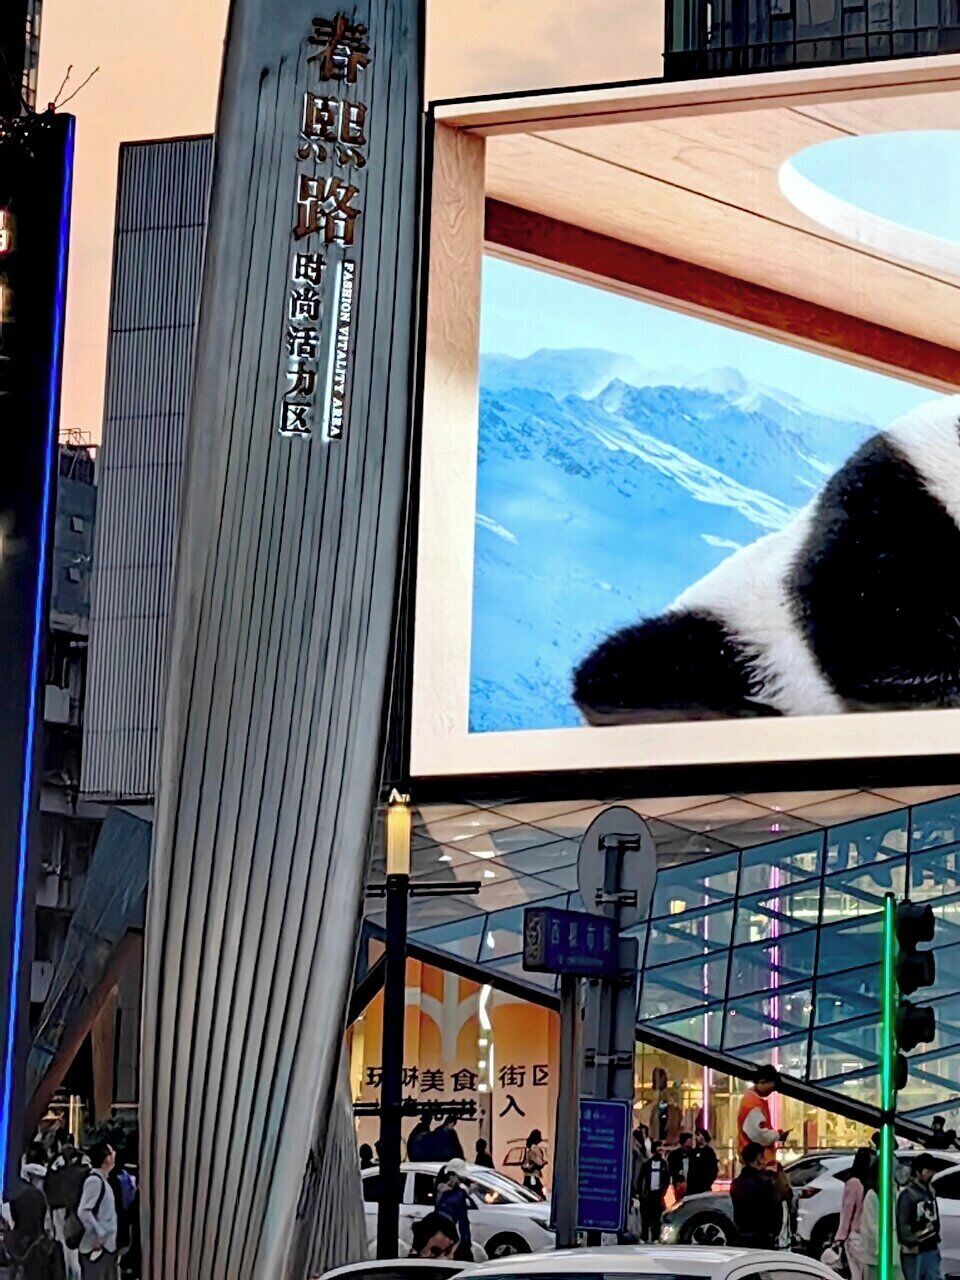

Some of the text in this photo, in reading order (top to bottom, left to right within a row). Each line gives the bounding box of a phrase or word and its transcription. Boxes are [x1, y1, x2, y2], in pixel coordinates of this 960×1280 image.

[293, 10, 371, 248] 春熙路
[279, 252, 327, 436] 时尚活力区
[339, 262, 355, 320] FASHION
[333, 325, 350, 394] VITALITY
